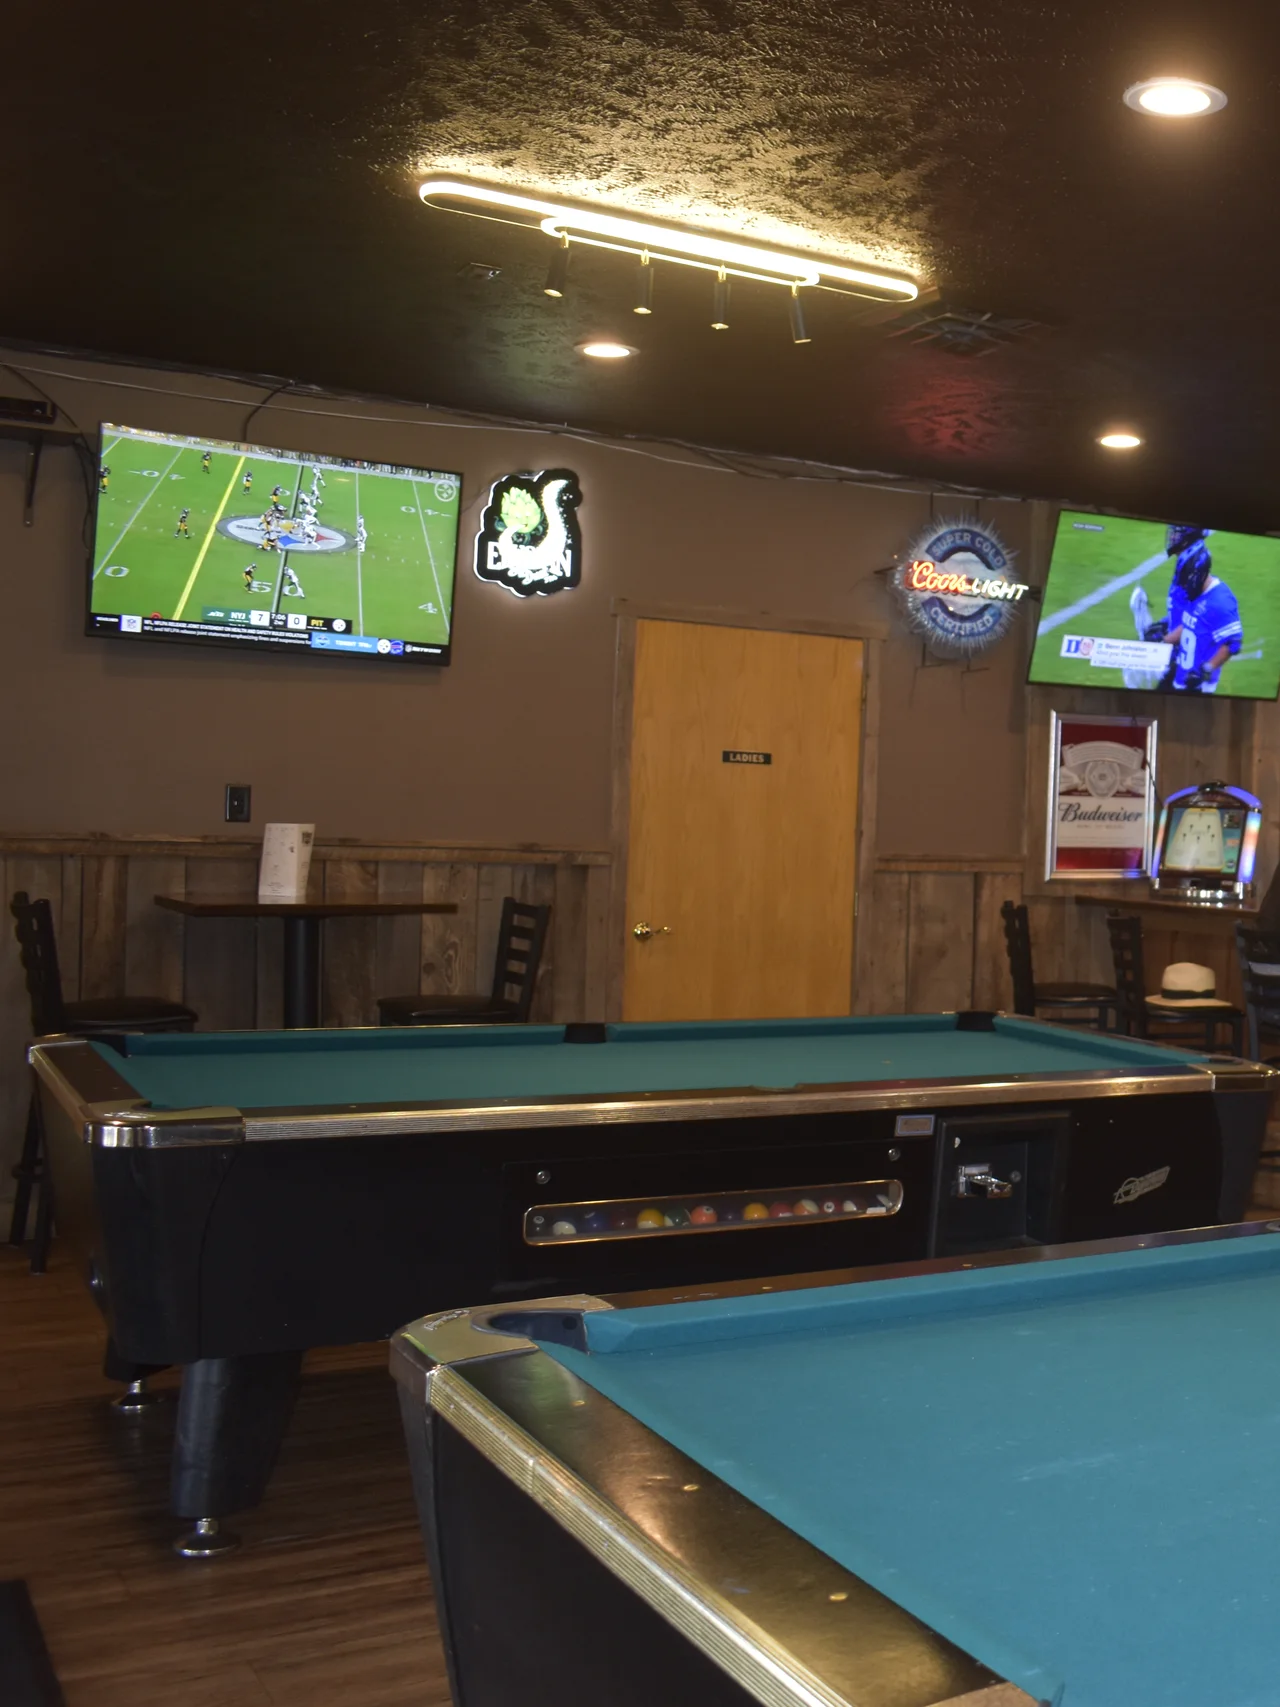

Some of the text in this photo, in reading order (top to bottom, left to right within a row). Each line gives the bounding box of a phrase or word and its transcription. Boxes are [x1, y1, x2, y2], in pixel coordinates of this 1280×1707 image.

[931, 532, 1004, 566] SUPER COLD
[911, 560, 1030, 600] Coors LIGHT
[230, 611, 246, 620] NYJ
[271, 613, 286, 621] 7:06
[293, 617, 300, 625] 0
[310, 619, 324, 628] PIT
[930, 606, 994, 635] CERTIFIED
[728, 752, 765, 763] LADIES
[1058, 802, 1145, 823] Budweiser
